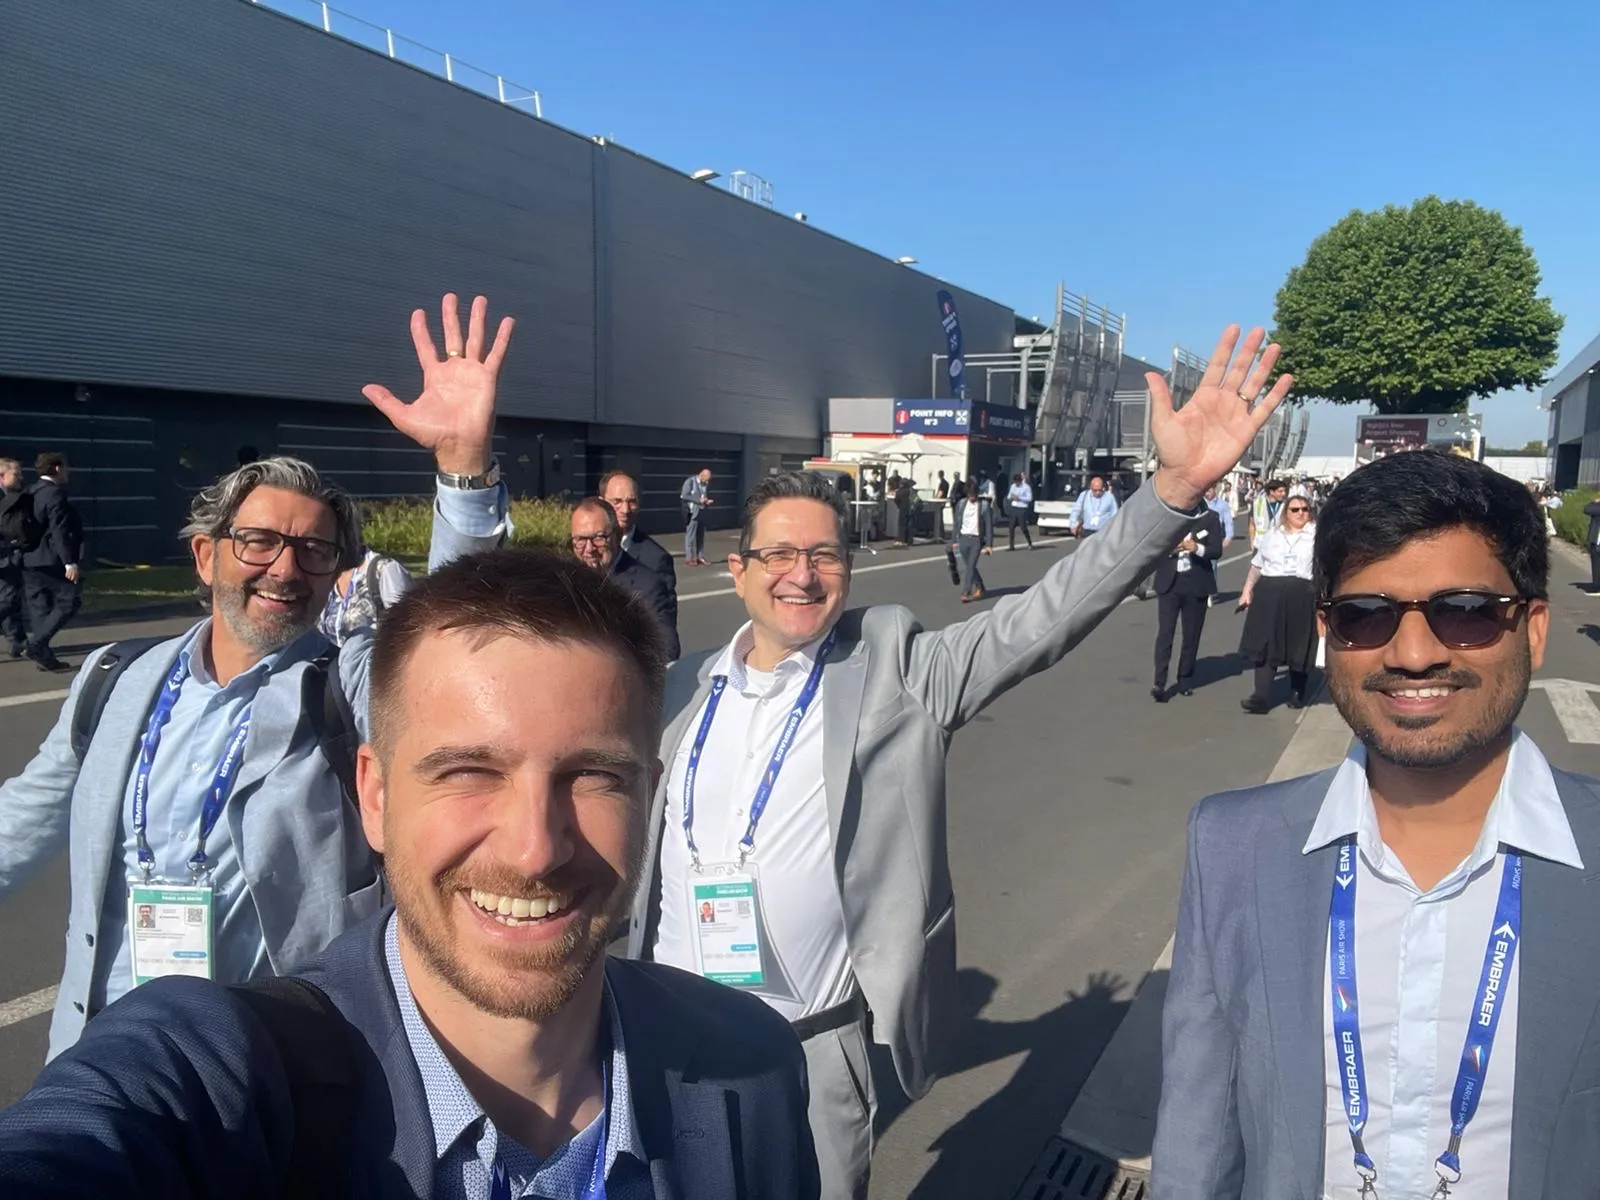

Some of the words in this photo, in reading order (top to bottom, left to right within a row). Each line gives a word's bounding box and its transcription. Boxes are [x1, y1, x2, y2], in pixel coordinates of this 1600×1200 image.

[909, 410, 932, 418] POINT
[934, 410, 954, 418] INFO
[220, 728, 246, 778] EMBRAER
[134, 773, 146, 825] EMBRAER
[1338, 919, 1346, 940] SHOW
[1338, 955, 1346, 975] PARIS
[1479, 941, 1508, 1027] EMBRAER
[1343, 1031, 1361, 1116] EMBRAER
[1463, 1081, 1475, 1101] PARIS
